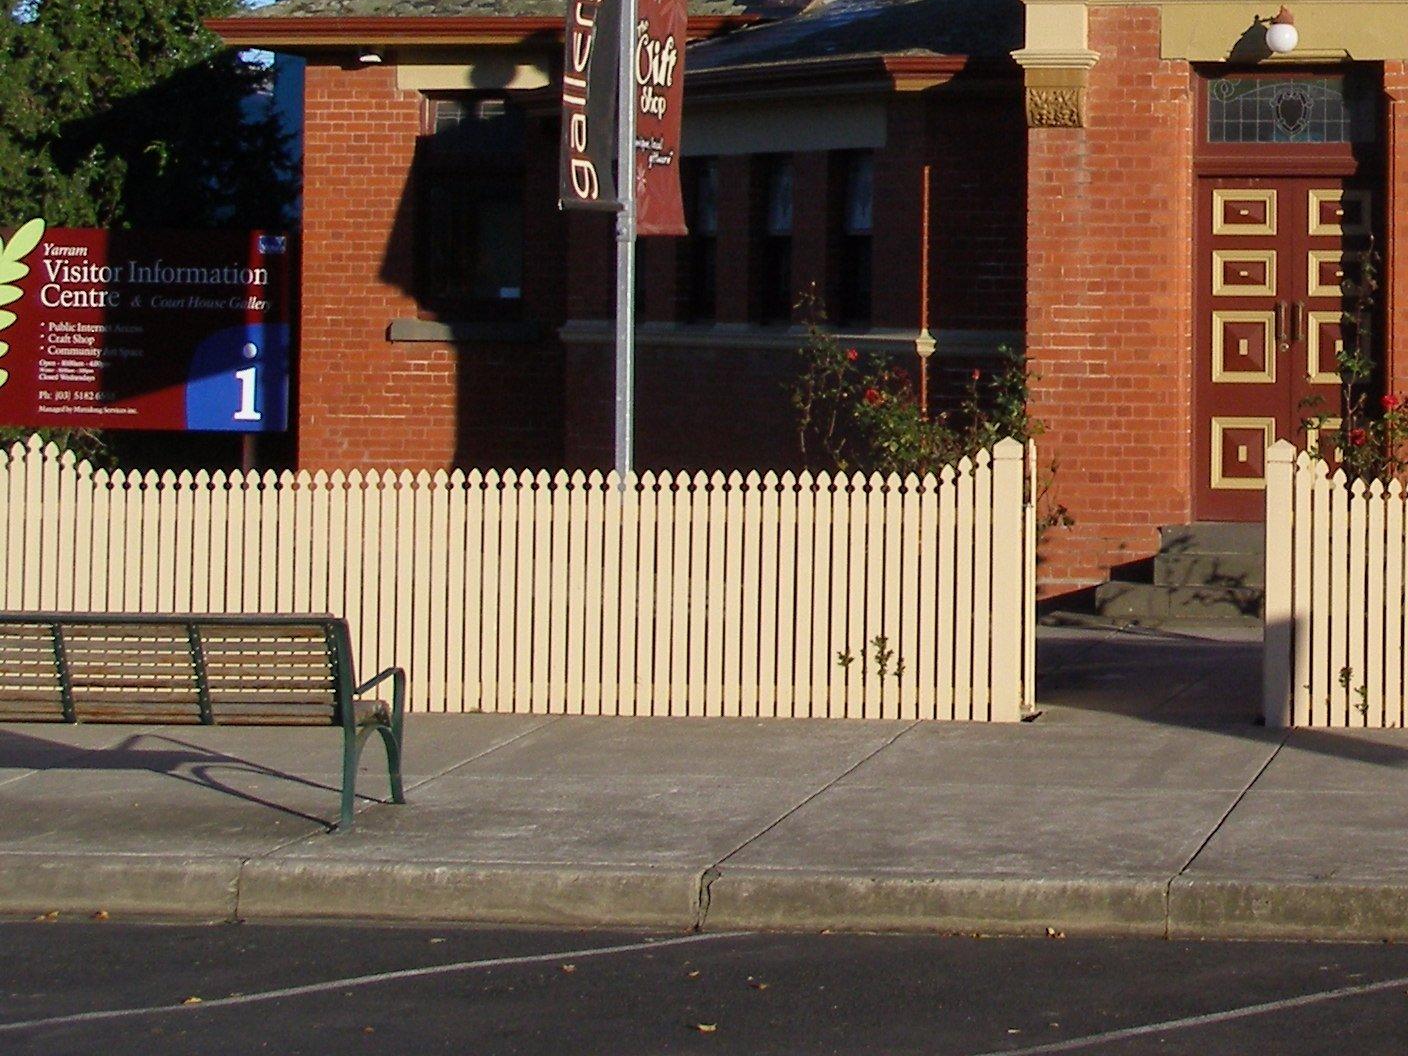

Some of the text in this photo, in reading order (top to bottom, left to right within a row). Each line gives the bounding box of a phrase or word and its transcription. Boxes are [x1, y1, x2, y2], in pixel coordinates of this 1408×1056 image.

[635, 33, 677, 87] Gift
[641, 86, 667, 120] Shop
[43, 243, 88, 257] Yarram
[44, 258, 270, 286] Visitor Information
[40, 284, 120, 308] Centre
[131, 296, 143, 308] &
[188, 296, 226, 310] House
[48, 322, 76, 333] Public
[47, 333, 72, 344] Craft
[47, 345, 102, 358] Community
